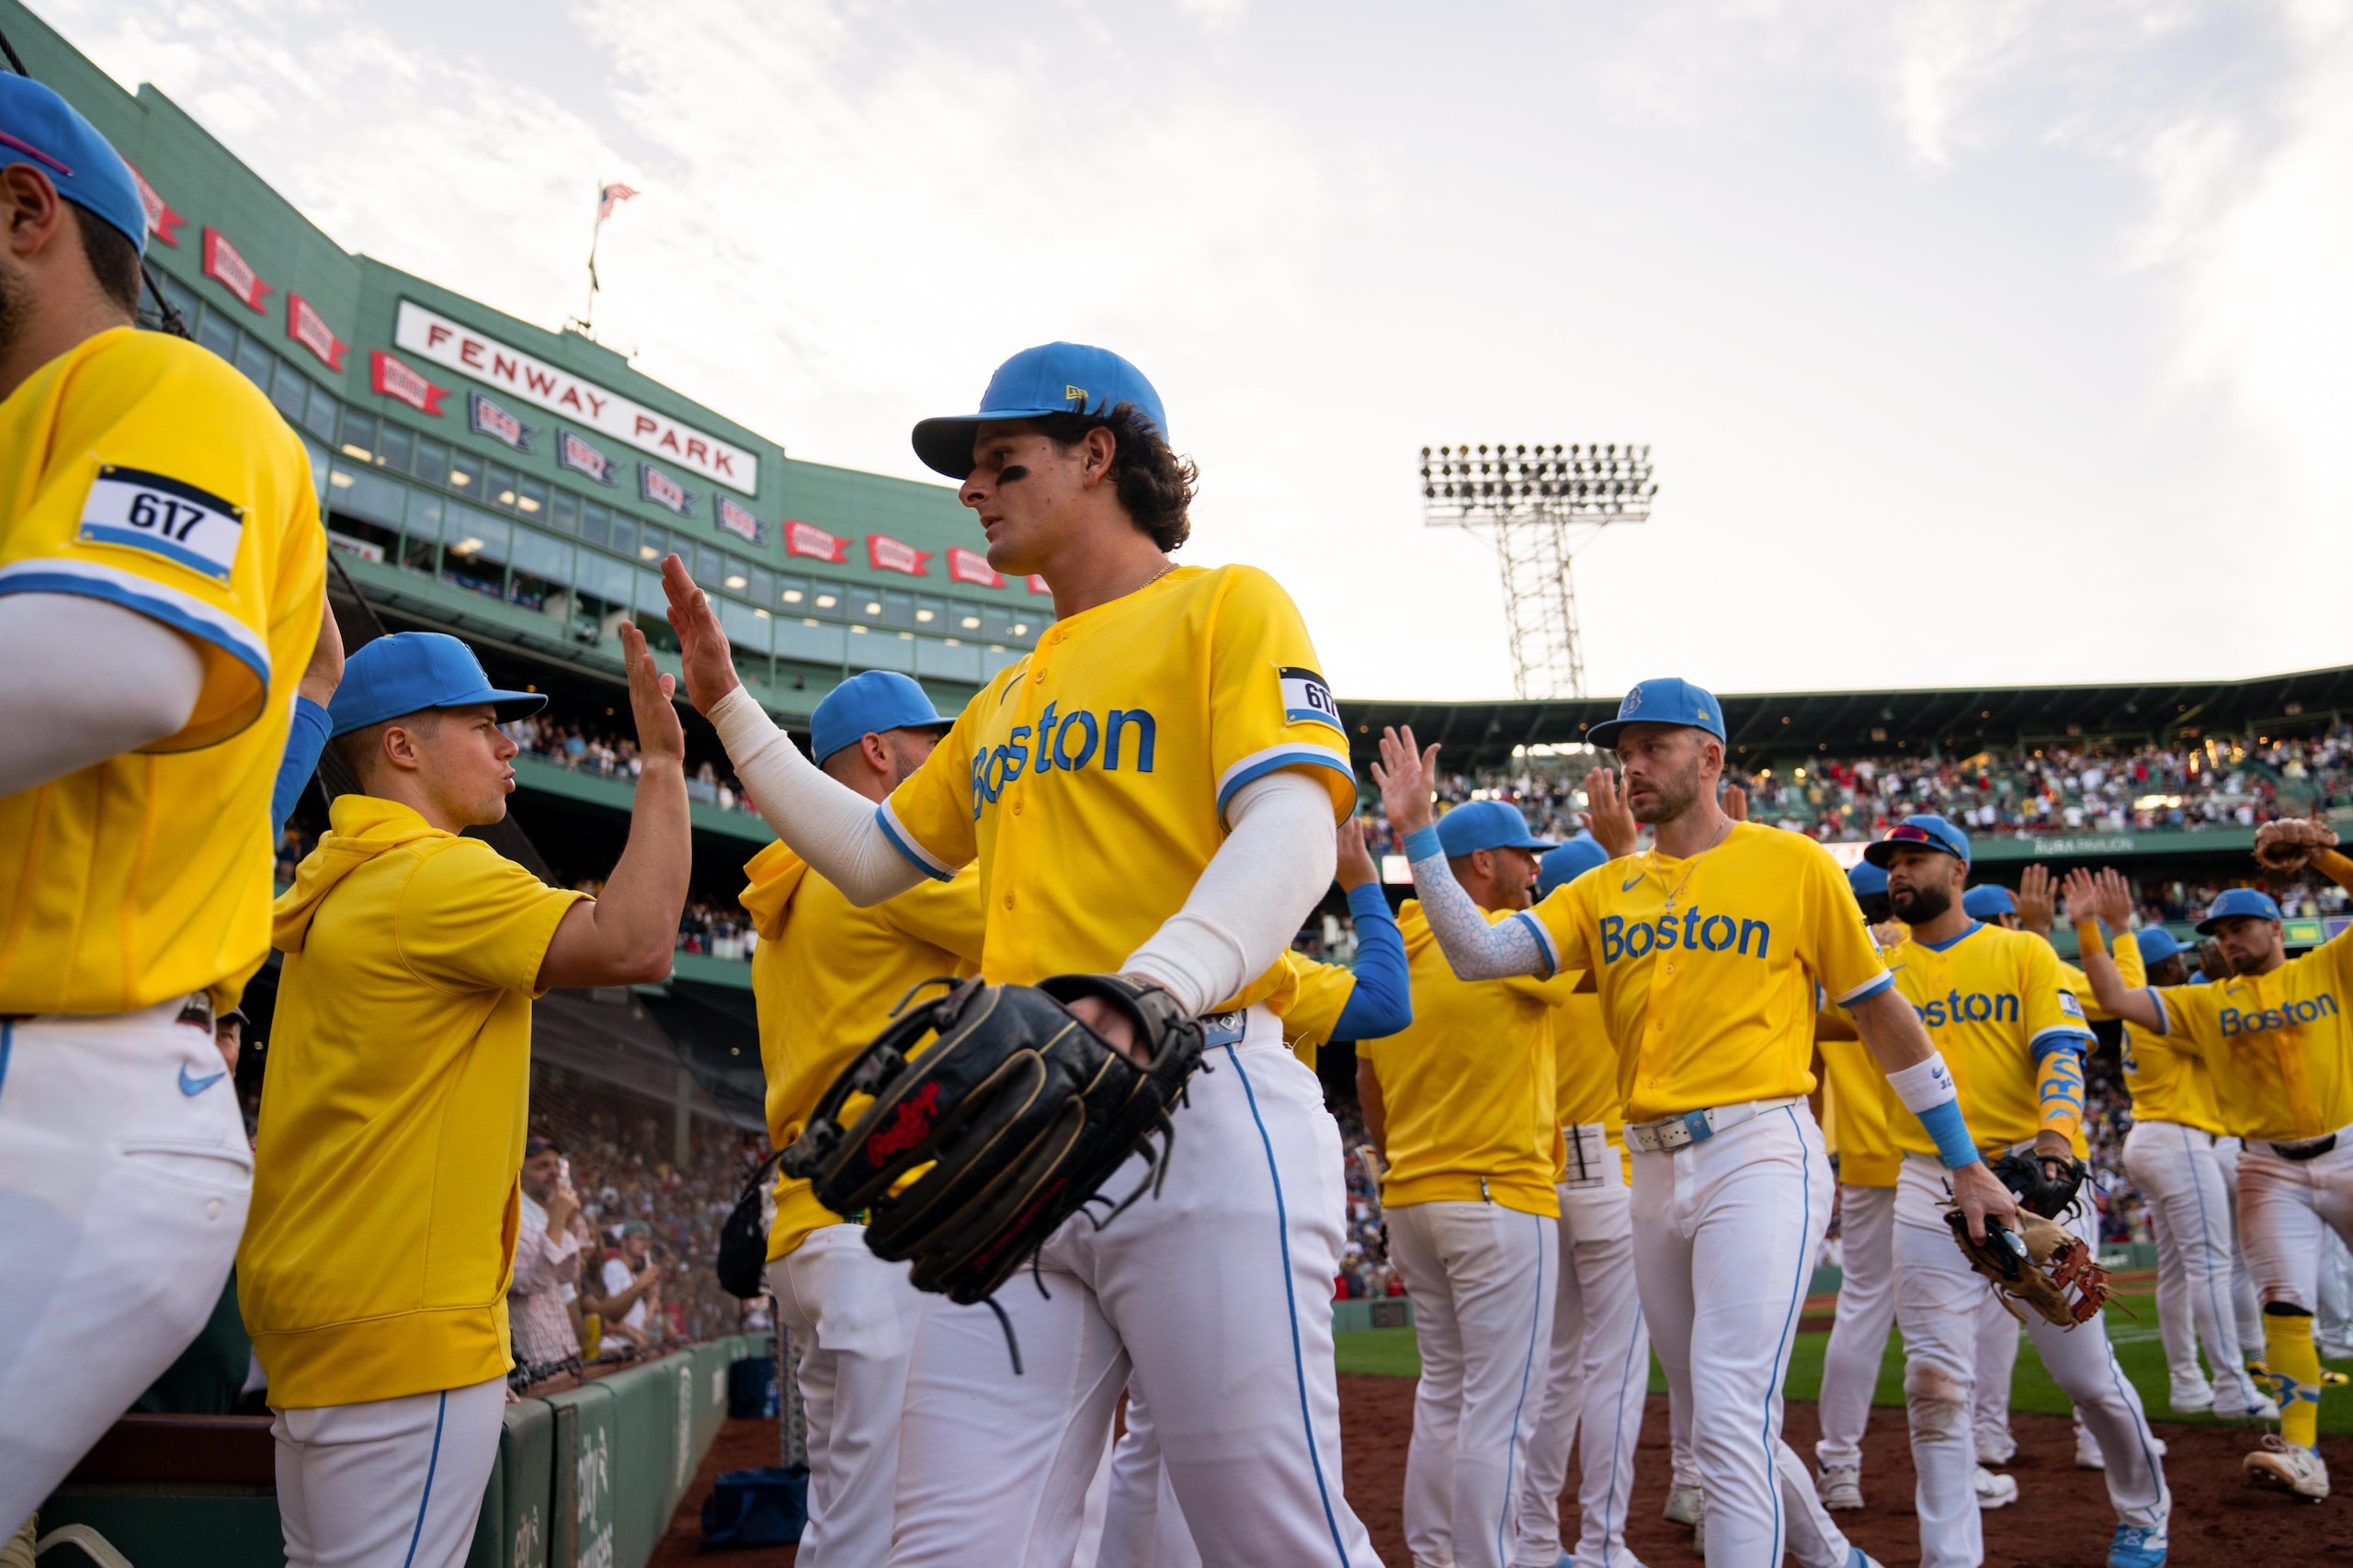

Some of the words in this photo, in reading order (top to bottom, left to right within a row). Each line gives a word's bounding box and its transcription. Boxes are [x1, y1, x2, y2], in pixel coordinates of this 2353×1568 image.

[427, 323, 608, 418] FENWAY
[634, 415, 734, 477] PARK
[128, 492, 206, 543] 617
[971, 699, 1156, 821] Boston
[1599, 905, 1771, 965] Boston
[1912, 988, 2019, 1027] ston
[2219, 993, 2338, 1038] Boston
